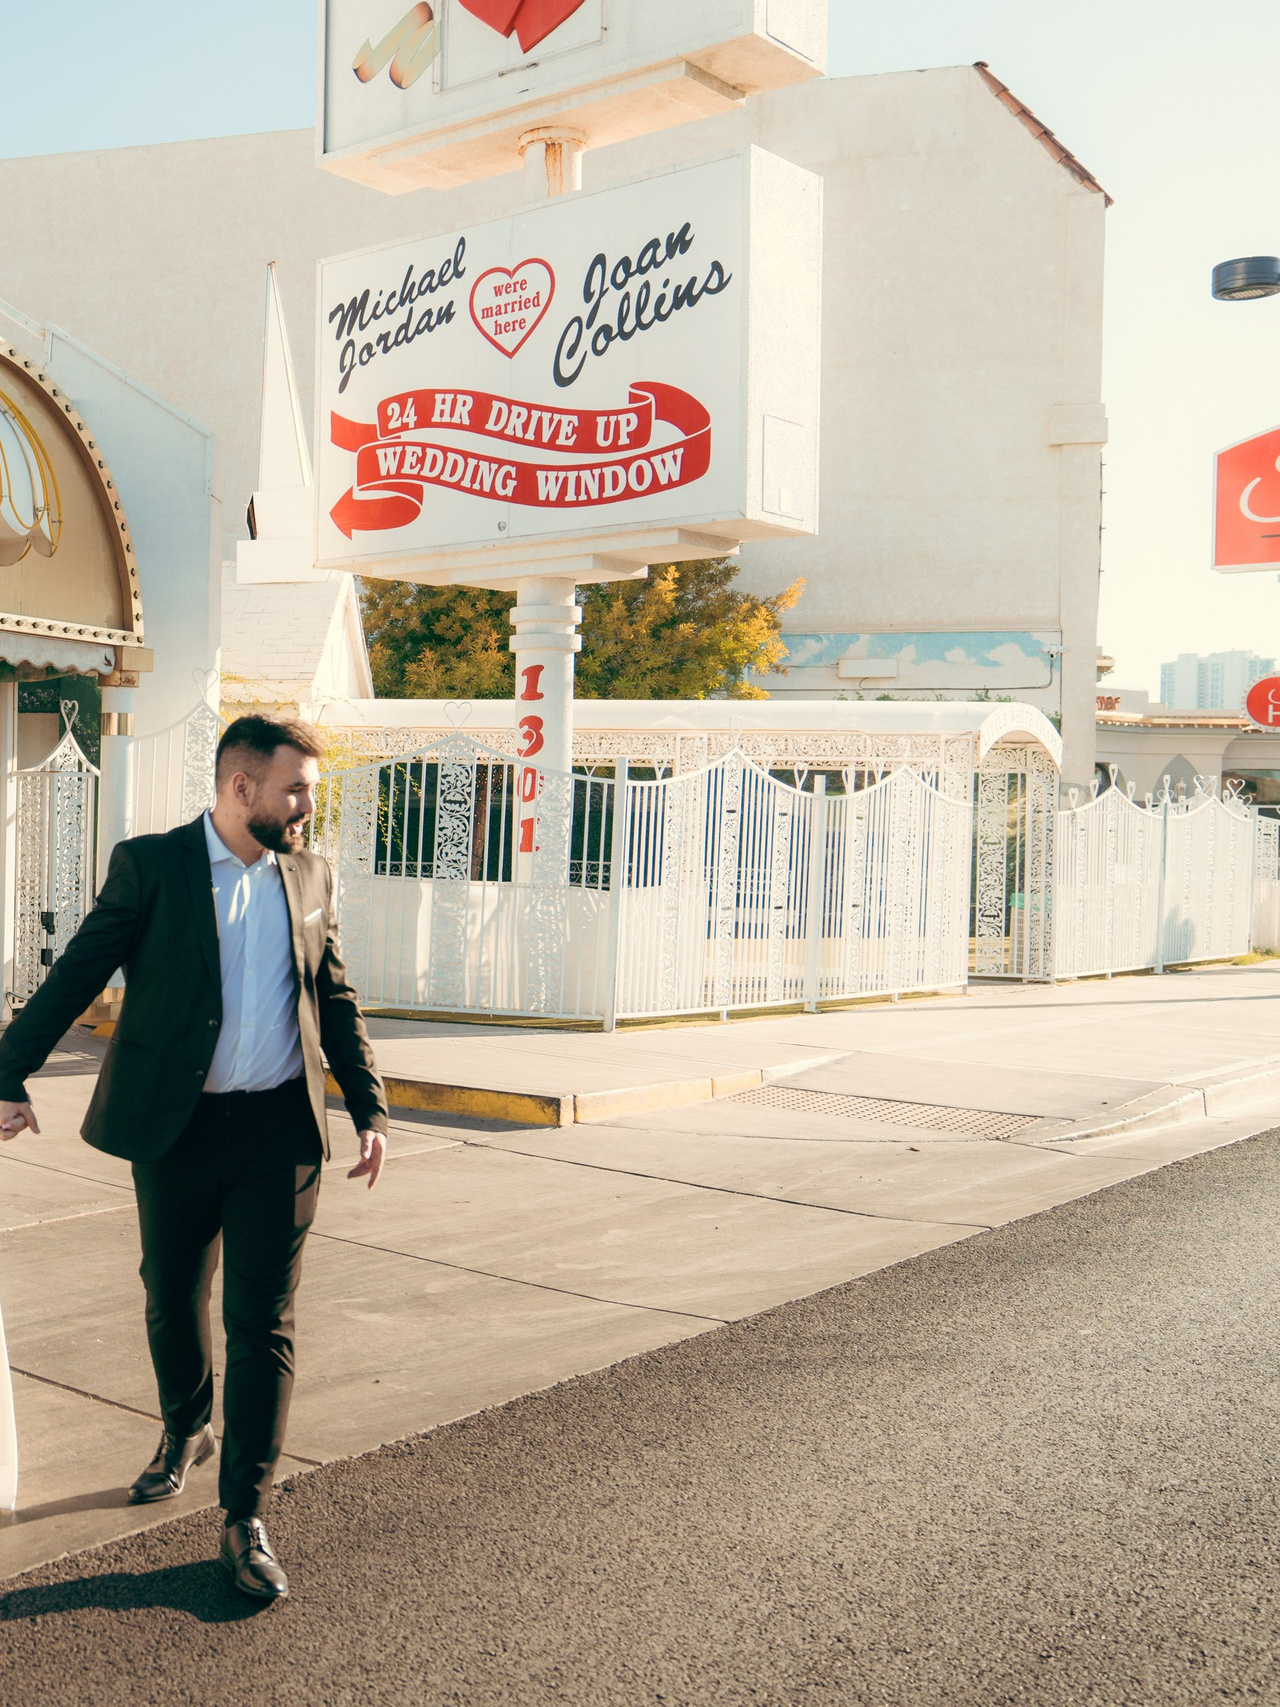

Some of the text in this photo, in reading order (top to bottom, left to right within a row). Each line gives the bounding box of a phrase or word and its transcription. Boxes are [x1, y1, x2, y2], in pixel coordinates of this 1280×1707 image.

[328, 236, 467, 341] Michael
[493, 277, 528, 298] were
[583, 222, 695, 330] Joan
[480, 291, 541, 320] married
[493, 315, 527, 336] here
[553, 260, 733, 388] Collins
[338, 299, 457, 394] Jordan
[387, 393, 639, 447] 24 HR DRIVE UP
[375, 448, 686, 502] WEDDING WINDOW
[1009, 709, 1033, 727] WHITE
